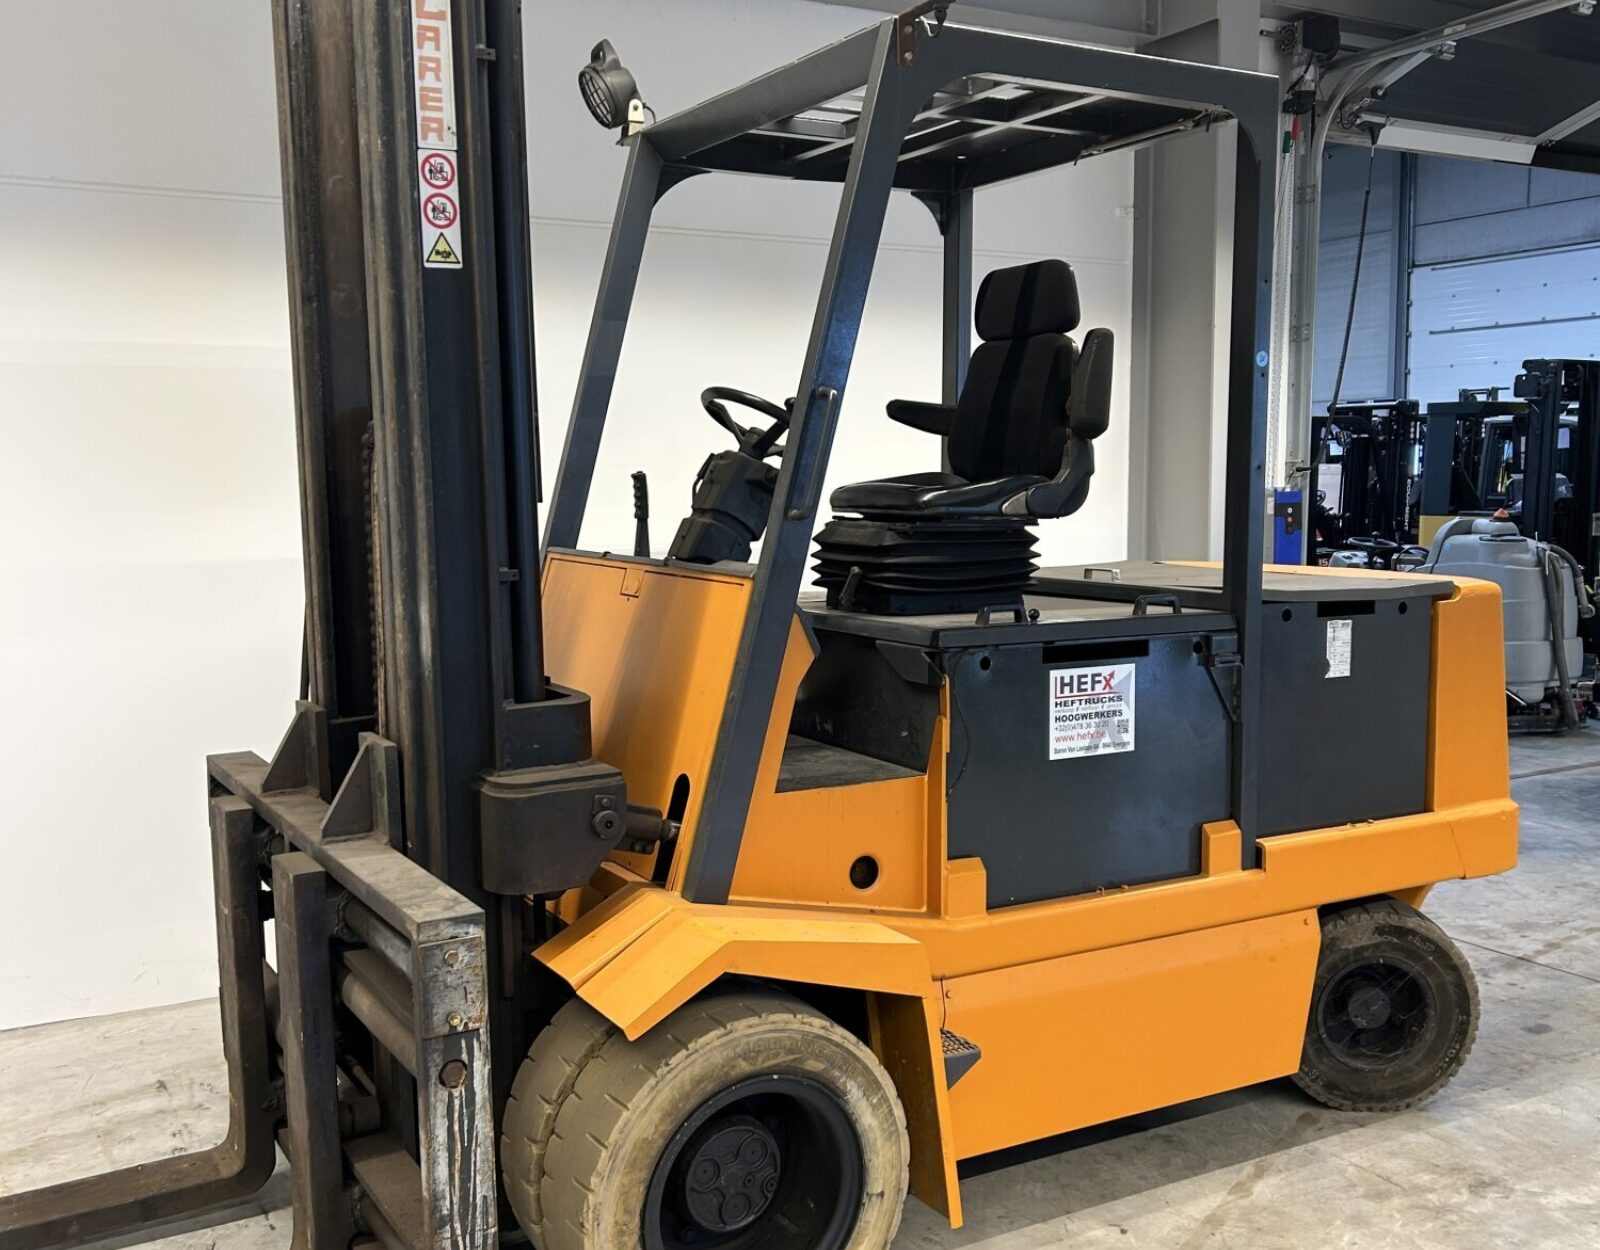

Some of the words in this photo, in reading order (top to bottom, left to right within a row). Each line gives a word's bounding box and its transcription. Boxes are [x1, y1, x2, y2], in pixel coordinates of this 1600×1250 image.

[1055, 695, 1123, 708] HEFTRUCKS
[1055, 709, 1123, 723] HOOGWERKERS
[1055, 730, 1107, 743] www.hefx.be
